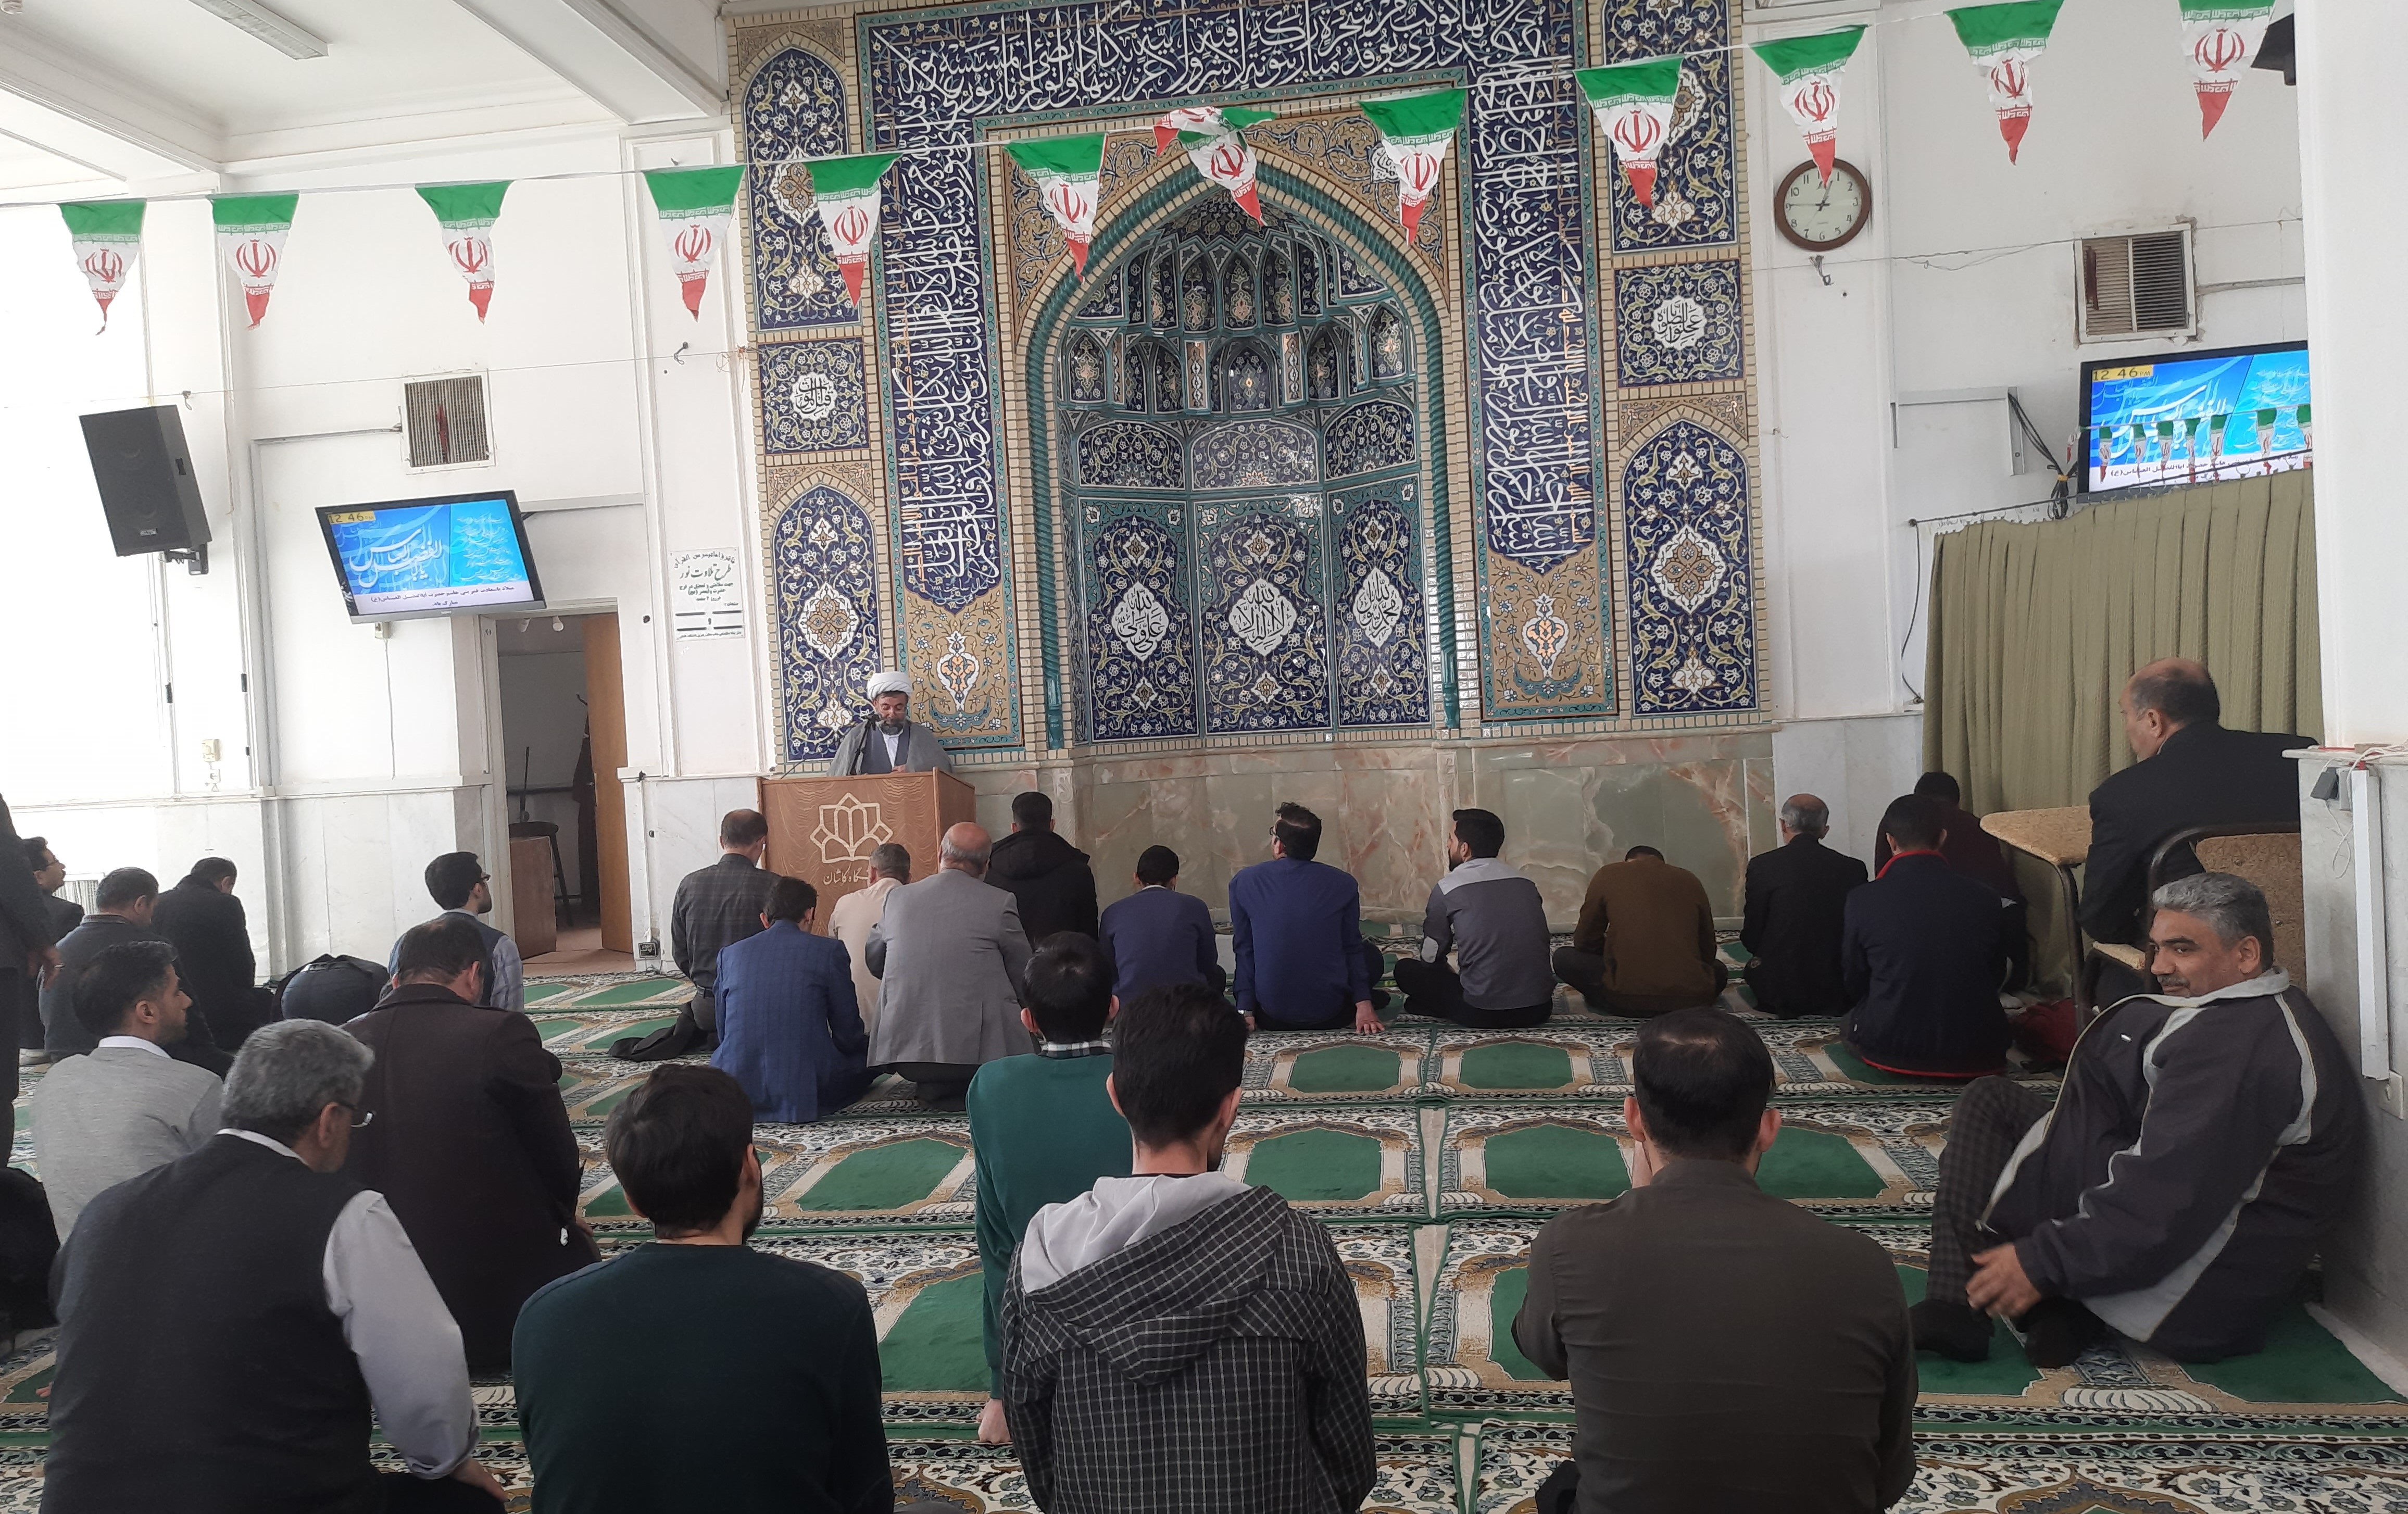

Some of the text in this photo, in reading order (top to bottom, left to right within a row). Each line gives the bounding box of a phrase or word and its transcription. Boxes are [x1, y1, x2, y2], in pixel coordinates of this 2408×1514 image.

[1803, 174, 1809, 184] 11
[1836, 171, 1839, 181] 1
[1847, 182, 1853, 191] 2
[1790, 187, 1799, 196] 10
[1852, 197, 1858, 206] 3
[1846, 214, 1852, 222] 4
[1791, 219, 1797, 228] 8
[1803, 229, 1809, 238] 7
[2093, 370, 2109, 381] 12
[2117, 368, 2138, 379] 46
[329, 514, 342, 523] 12
[348, 513, 363, 521] 46
[680, 566, 690, 579] نور
